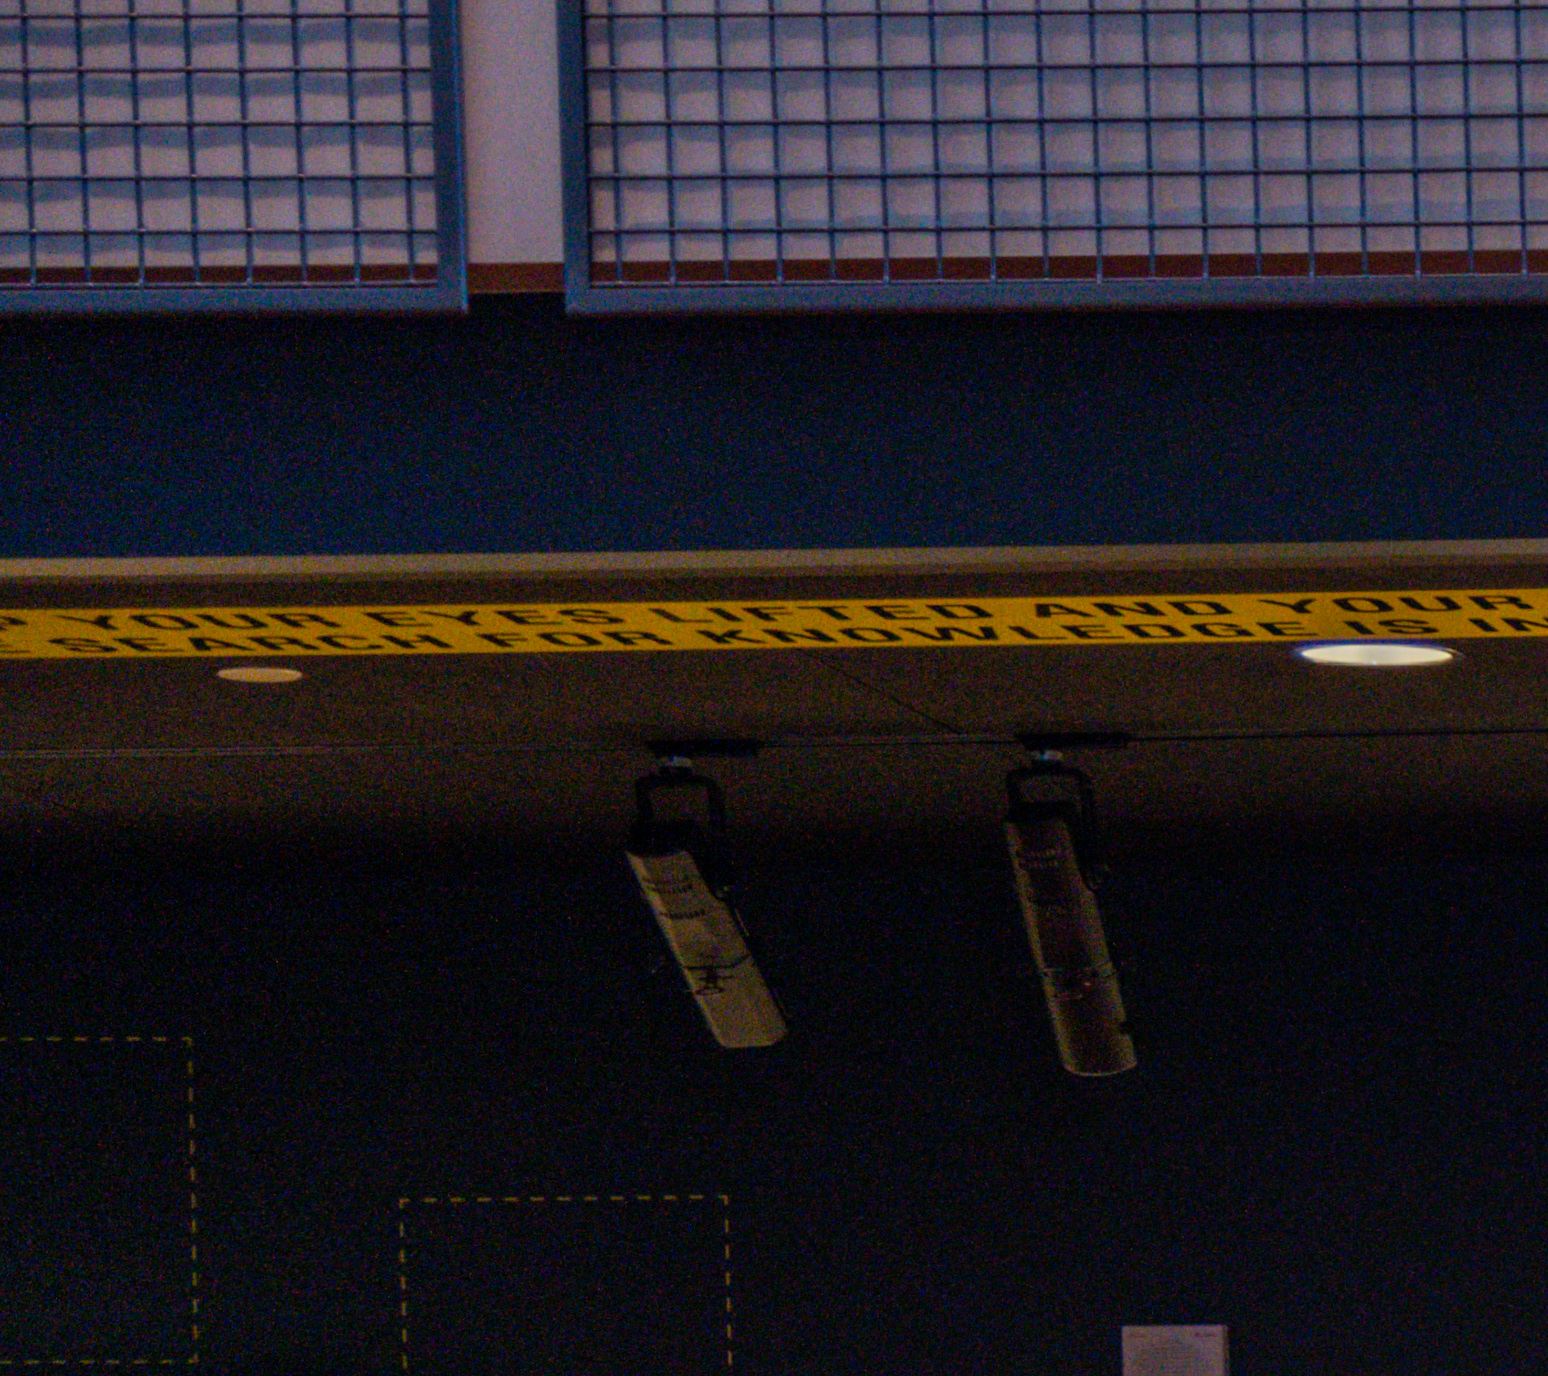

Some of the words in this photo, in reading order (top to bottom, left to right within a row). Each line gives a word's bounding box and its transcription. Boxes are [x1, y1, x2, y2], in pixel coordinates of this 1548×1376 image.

[65, 609, 343, 634] YOUR
[363, 606, 620, 629] EYES
[653, 601, 994, 626] LIFTED
[1032, 599, 1226, 621] AND
[1258, 594, 1536, 615] YOUR
[50, 634, 453, 655] SEARCH
[481, 631, 674, 650] FOR
[697, 621, 1319, 646] KNOWLEDGE
[1342, 619, 1437, 636] IS
